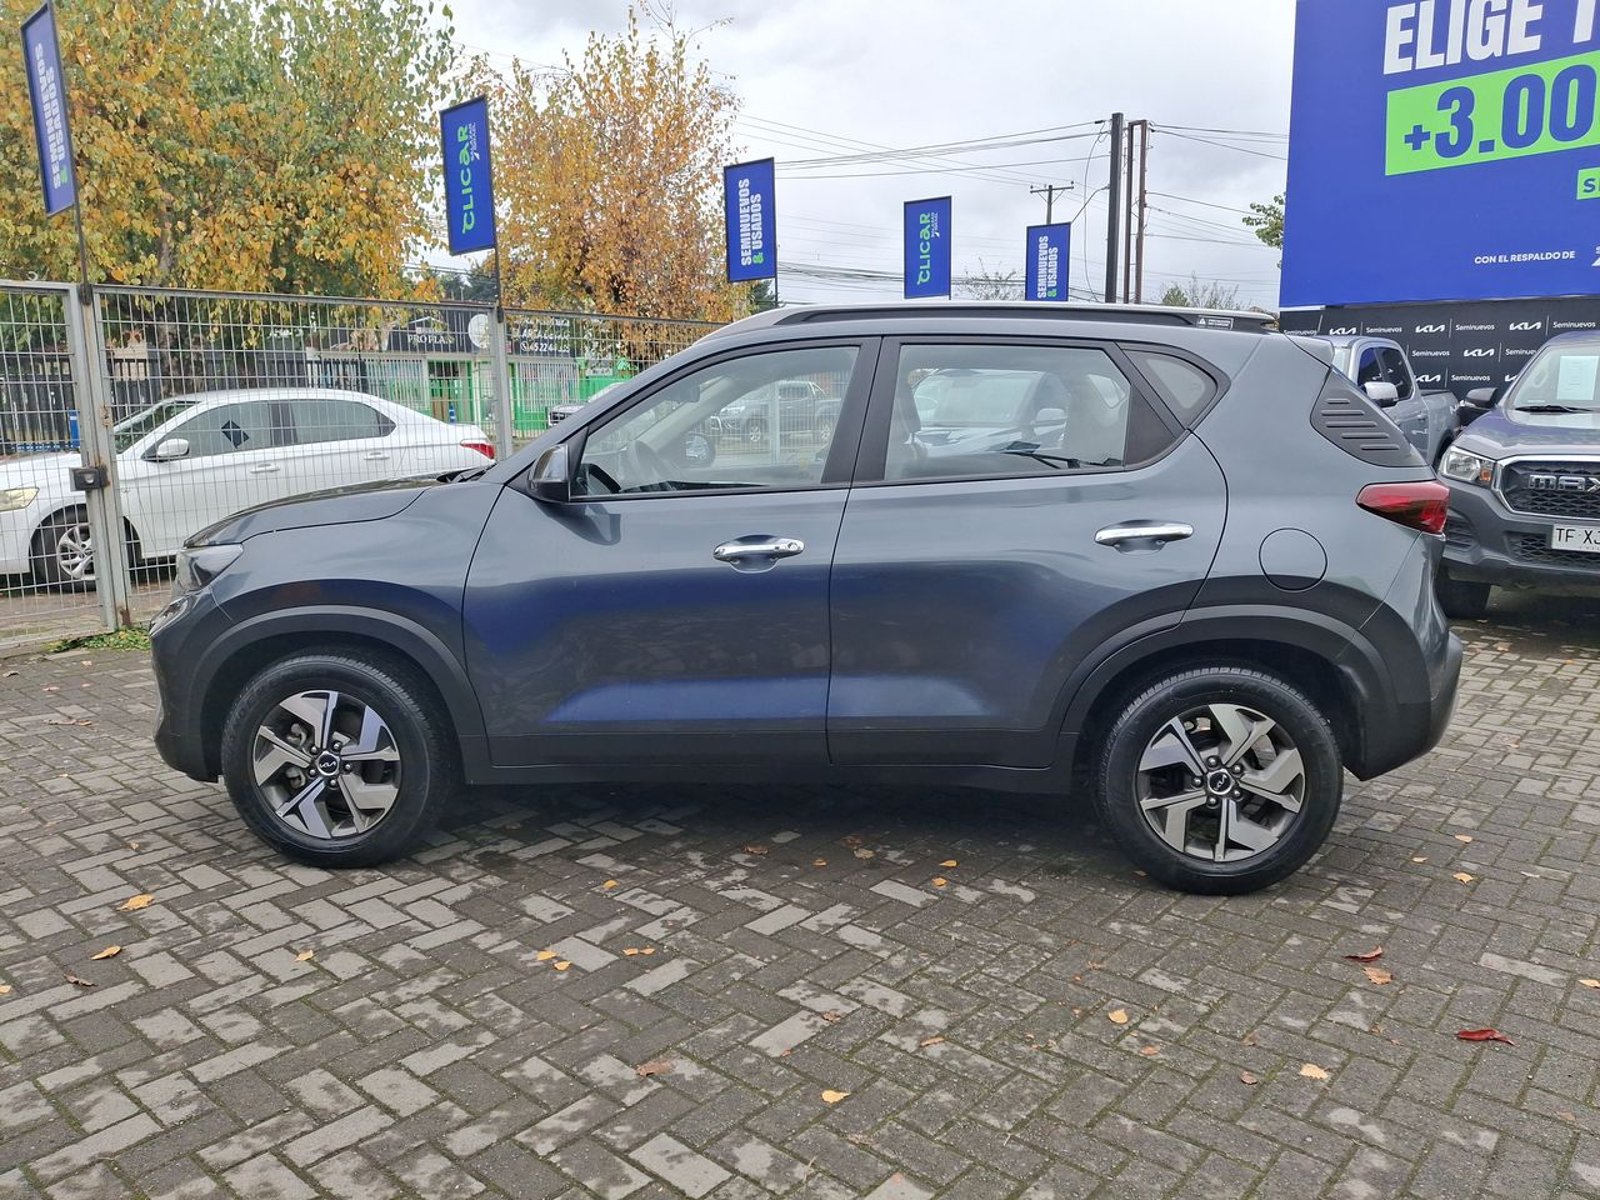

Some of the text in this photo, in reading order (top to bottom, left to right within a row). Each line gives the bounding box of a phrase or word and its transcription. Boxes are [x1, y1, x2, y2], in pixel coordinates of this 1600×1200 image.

[1383, 0, 1543, 75] ELIGE
[34, 43, 62, 190] SEMINUEVOS
[46, 67, 66, 162] USADOS
[738, 178, 752, 266] SEMINUEVOS
[750, 193, 764, 264] & USADOS
[1474, 250, 1576, 265] CON EL RESPALDO DE
[1037, 235, 1049, 299] SEMINUEVOS
[1047, 247, 1059, 298] & USADOS
[1329, 327, 1357, 336] KIA
[1415, 324, 1496, 334] KIA Seminuevos
[1509, 320, 1597, 331] KIA Seminuevos
[1411, 349, 1451, 358] Seminuevos
[1463, 348, 1495, 357] KIA
[1450, 374, 1491, 382] Seminuevos
[1556, 527, 1576, 543] TF
